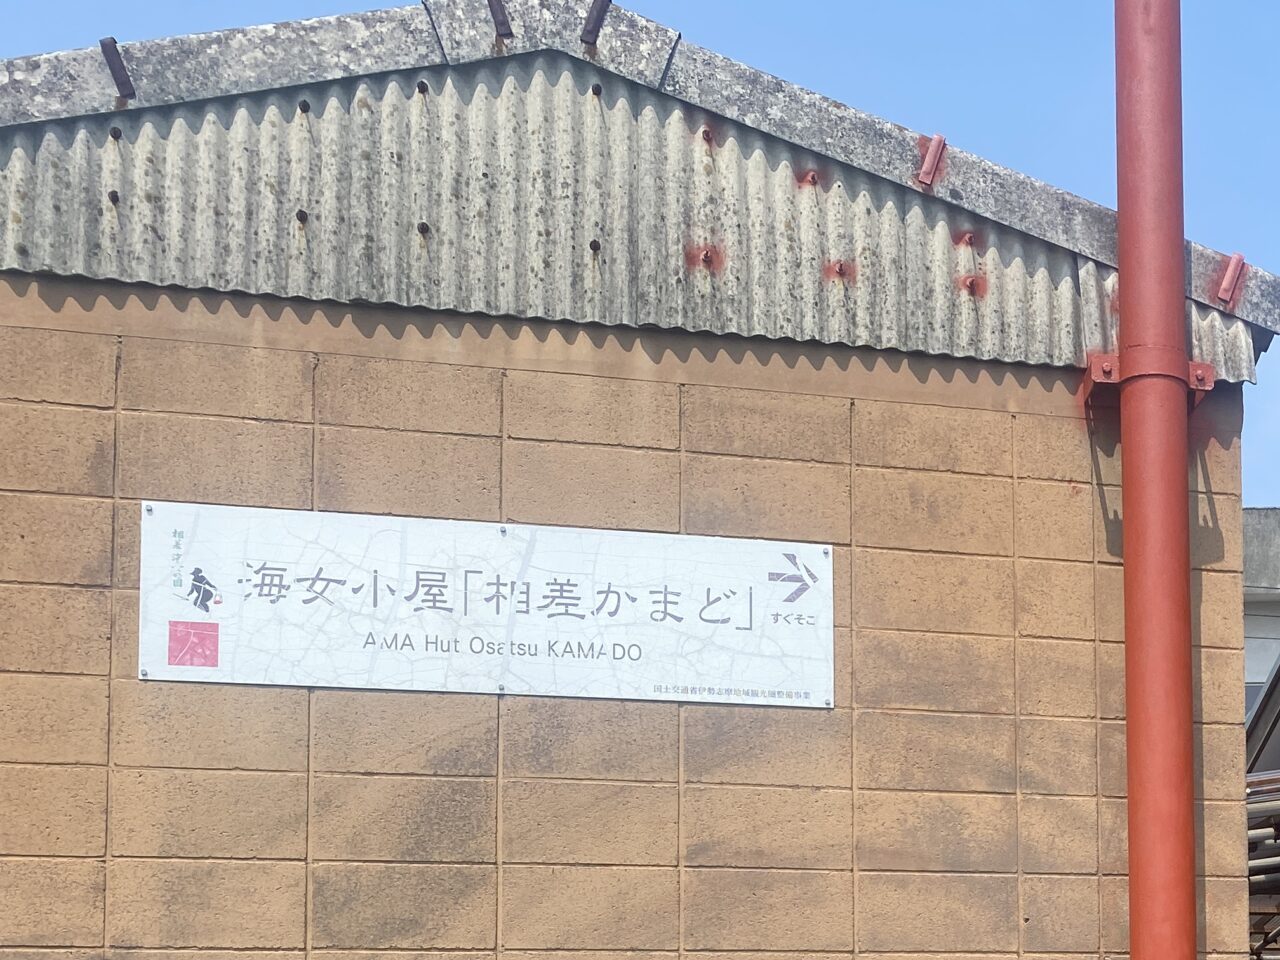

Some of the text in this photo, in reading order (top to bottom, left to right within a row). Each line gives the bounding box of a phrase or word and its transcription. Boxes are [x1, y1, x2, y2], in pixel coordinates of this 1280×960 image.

[237, 561, 753, 631] 海女小屋「相差かまど」
[770, 611, 816, 626] すぐそこ
[362, 631, 643, 661] AMA Hut Osatsu KAMADO
